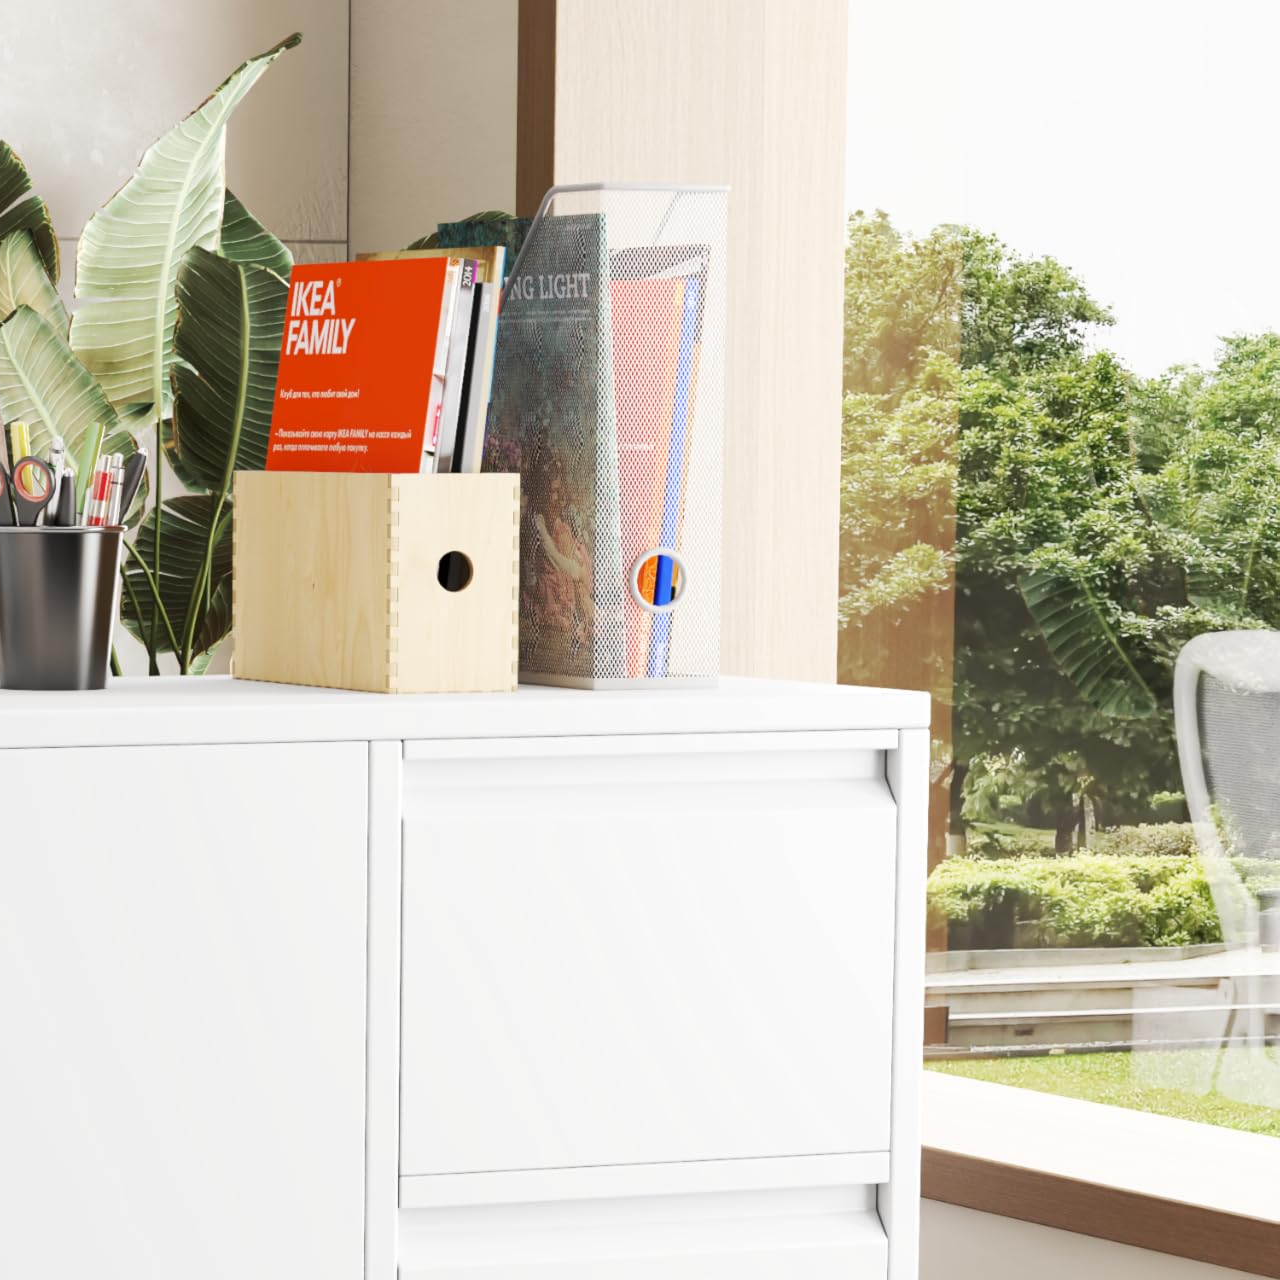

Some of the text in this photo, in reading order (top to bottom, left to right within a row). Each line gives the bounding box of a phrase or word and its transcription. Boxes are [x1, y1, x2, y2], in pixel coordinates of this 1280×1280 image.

[462, 266, 473, 287] 2014
[539, 272, 591, 299] LIGHT
[290, 280, 337, 317] IKEA
[285, 318, 356, 355] FAMILY
